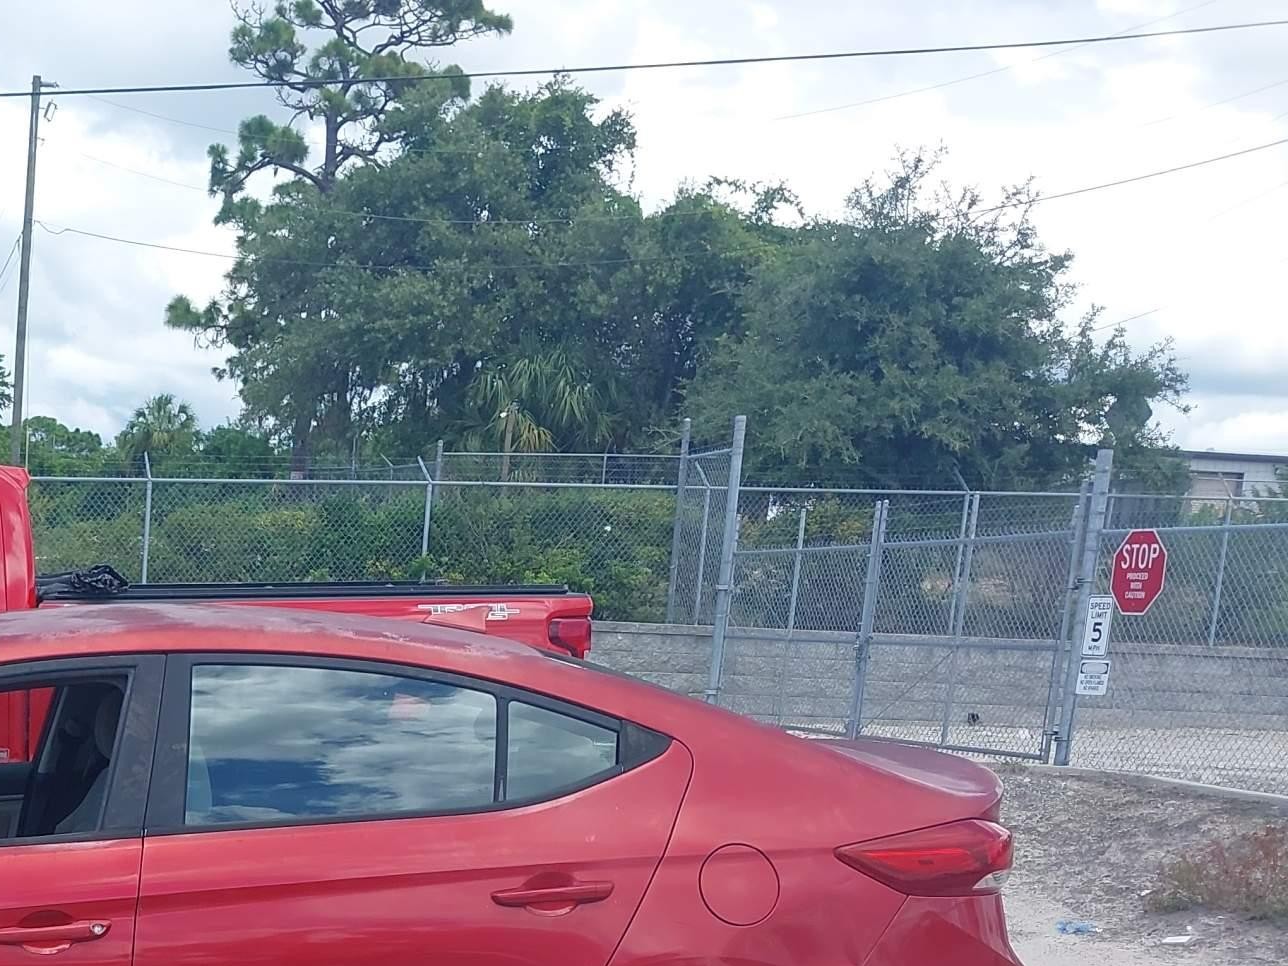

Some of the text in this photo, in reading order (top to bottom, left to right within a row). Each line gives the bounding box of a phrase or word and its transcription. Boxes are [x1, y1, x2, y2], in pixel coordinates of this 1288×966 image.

[1121, 543, 1160, 569] STOP
[1090, 602, 1111, 610] SPEED
[1090, 611, 1107, 619] LIMIT
[1091, 621, 1102, 643] 5
